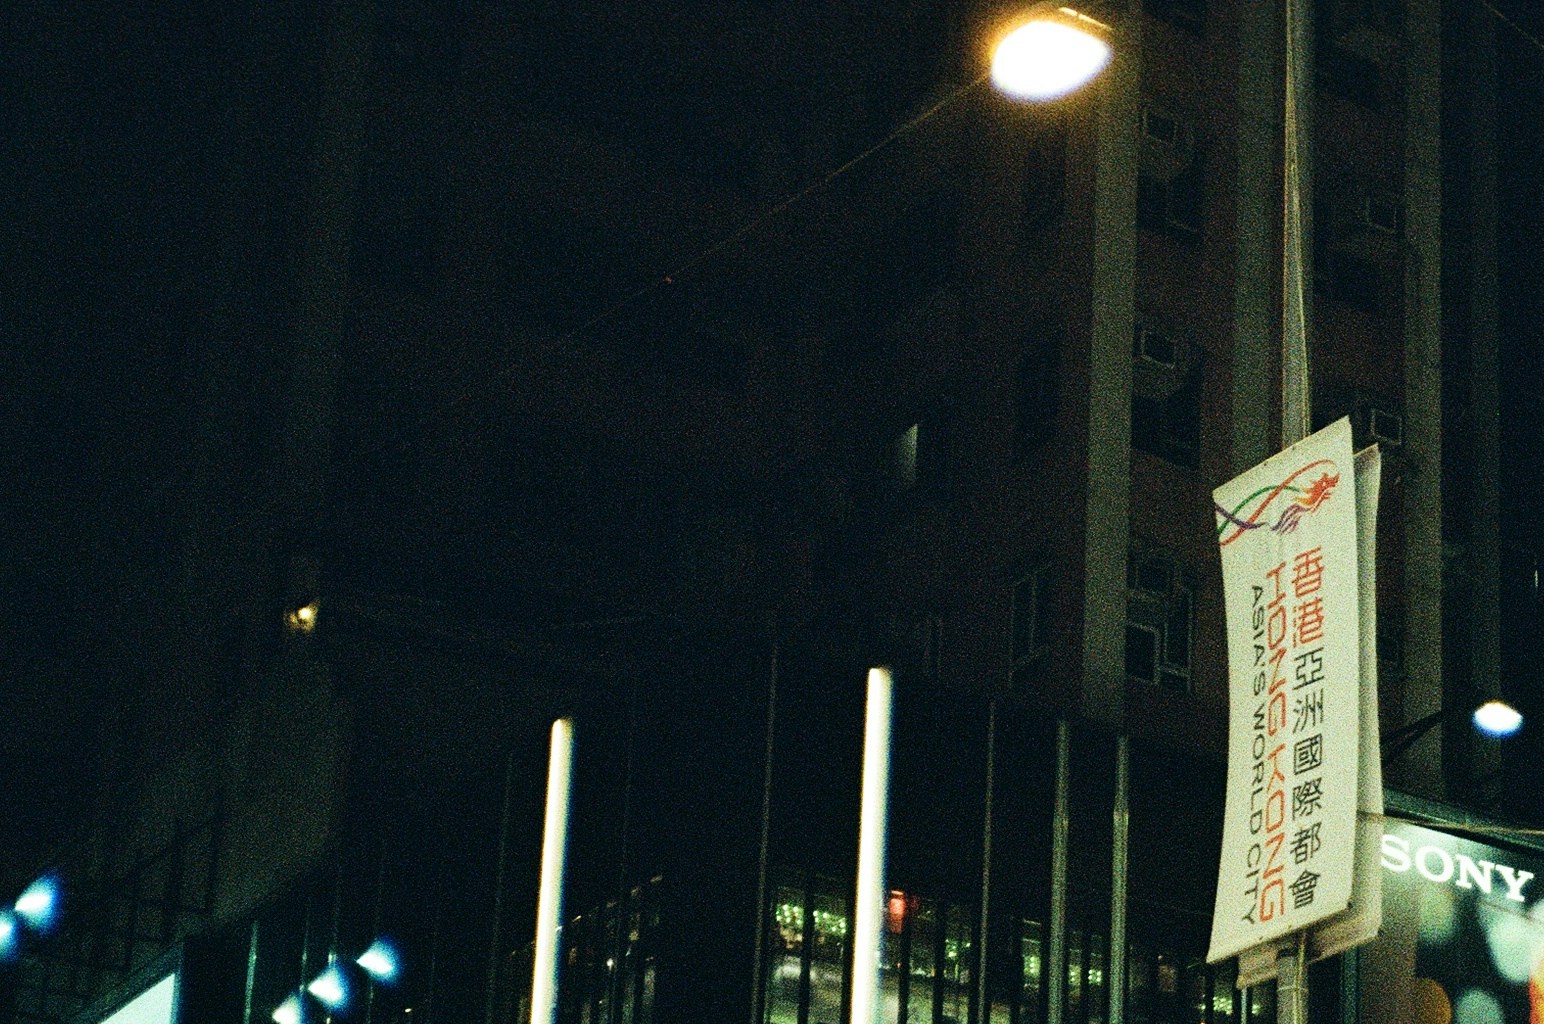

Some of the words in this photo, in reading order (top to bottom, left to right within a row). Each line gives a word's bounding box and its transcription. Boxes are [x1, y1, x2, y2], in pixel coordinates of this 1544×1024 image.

[1250, 584, 1267, 697] ASIA'S
[1265, 561, 1288, 736] HONG
[1246, 702, 1267, 832] WORLD
[1240, 840, 1264, 926] CITY
[1259, 742, 1287, 923] KONG
[1379, 834, 1536, 902] SONY
